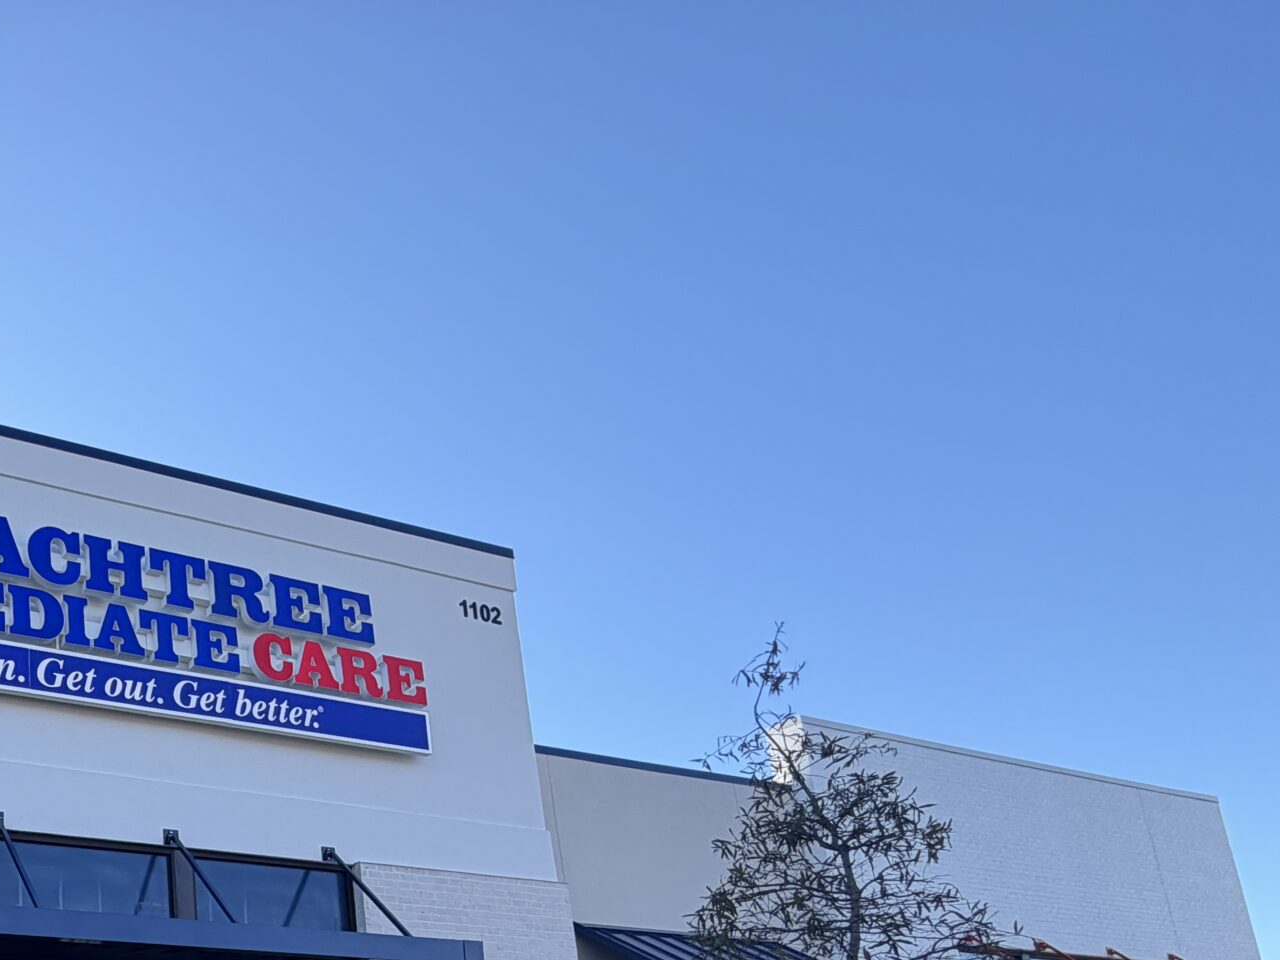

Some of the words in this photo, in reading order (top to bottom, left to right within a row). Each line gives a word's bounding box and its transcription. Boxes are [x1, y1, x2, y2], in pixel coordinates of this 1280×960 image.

[459, 599, 502, 626] 1102
[36, 657, 97, 694] Get
[104, 676, 164, 705] out.
[173, 680, 226, 714] Get
[252, 632, 428, 707] CARE
